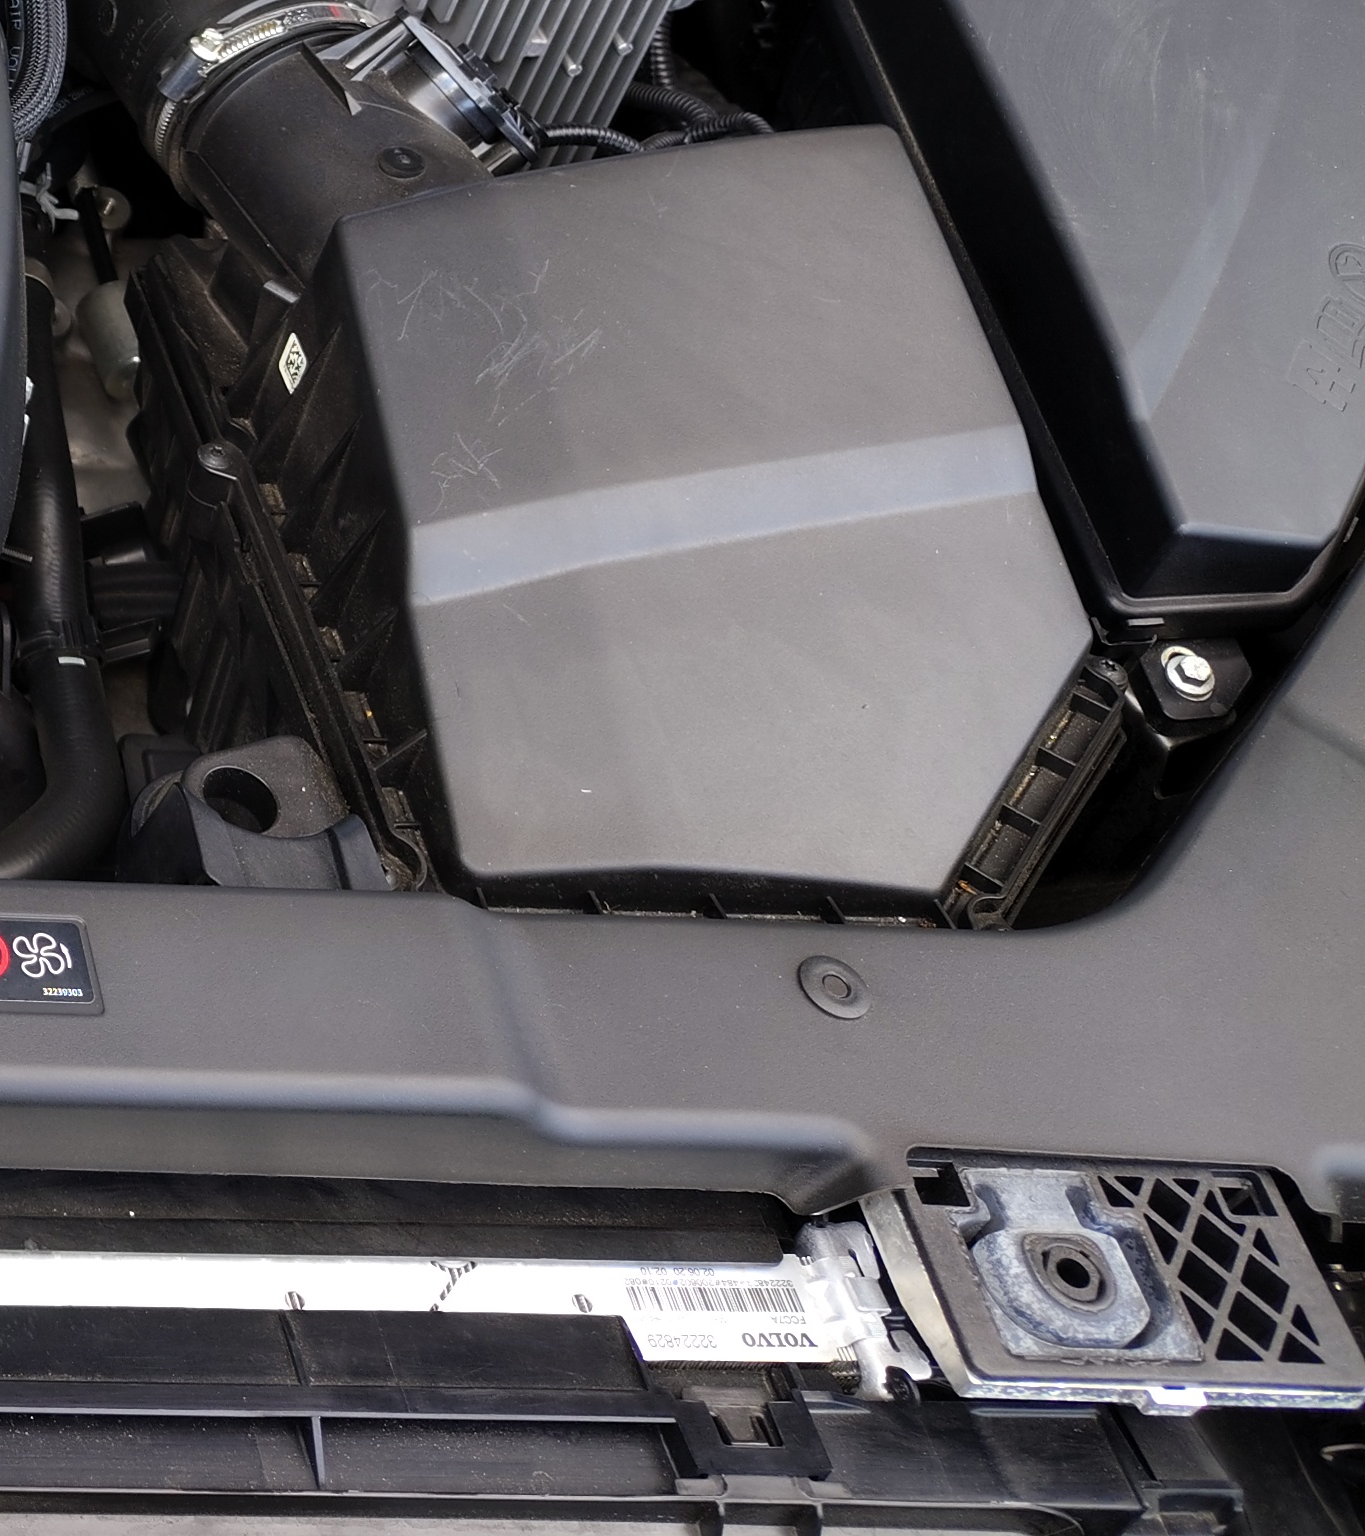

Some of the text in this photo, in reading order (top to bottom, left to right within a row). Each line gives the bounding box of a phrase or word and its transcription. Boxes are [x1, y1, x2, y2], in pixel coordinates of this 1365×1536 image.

[42, 987, 83, 997] 32239303
[647, 1333, 818, 1349] VOLVO 32224829
